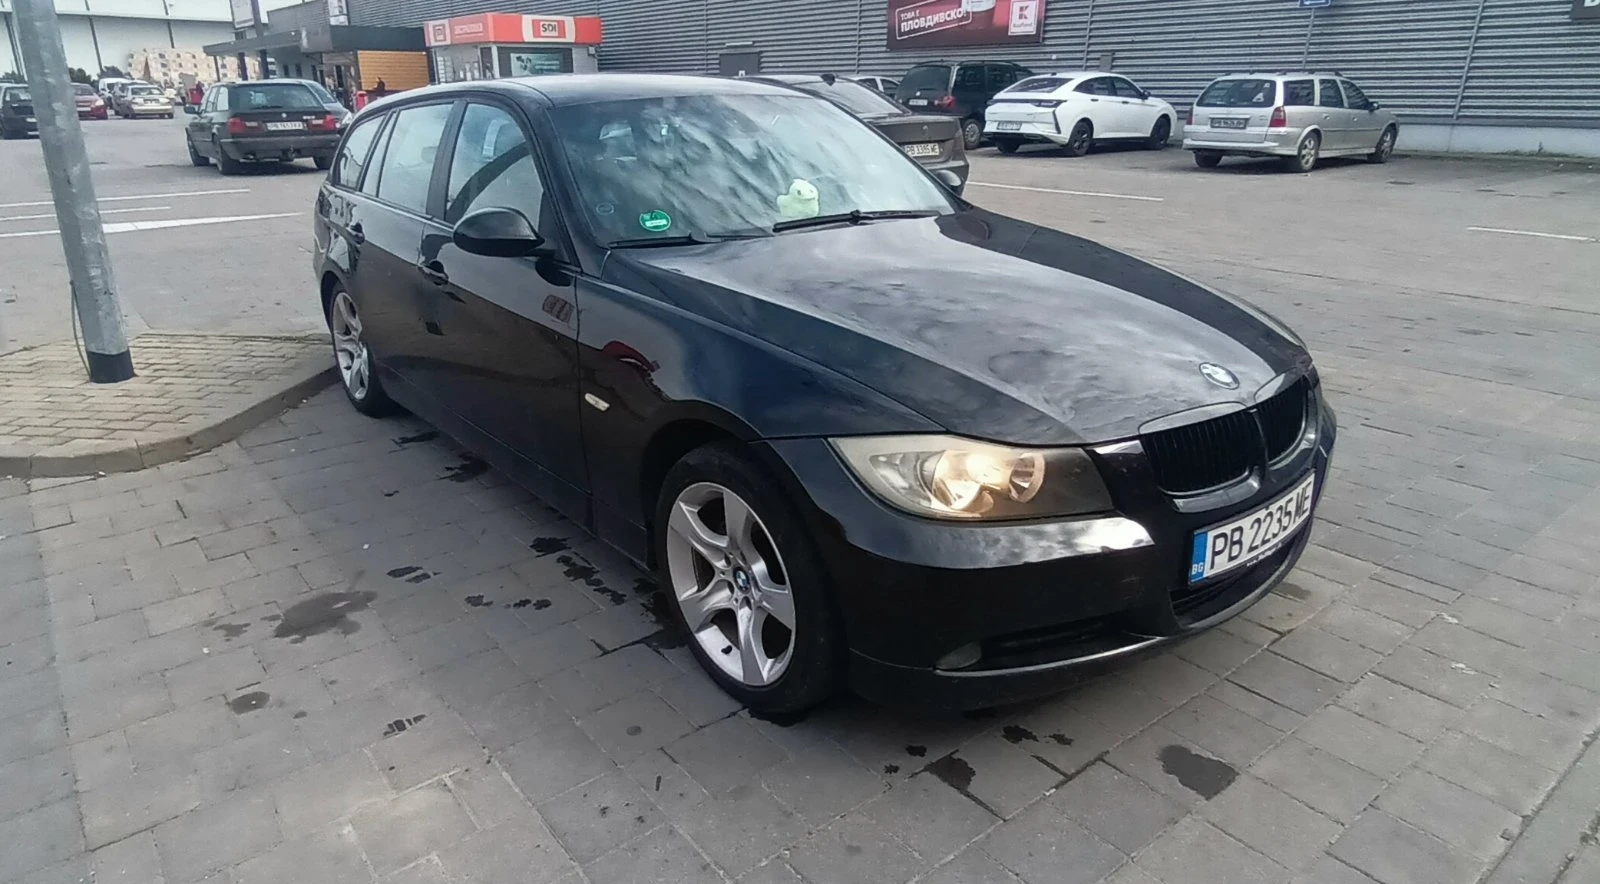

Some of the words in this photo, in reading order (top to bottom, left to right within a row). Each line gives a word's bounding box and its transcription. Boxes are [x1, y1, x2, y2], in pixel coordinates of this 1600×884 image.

[900, 12, 915, 21] ТОВА
[901, 7, 967, 33] ПЛОВДИВСКО!
[541, 23, 557, 33] SDI
[1210, 525, 1244, 569] PB
[1247, 497, 1293, 554] 2235
[1293, 481, 1312, 524] ME
[1191, 562, 1204, 575] BG
